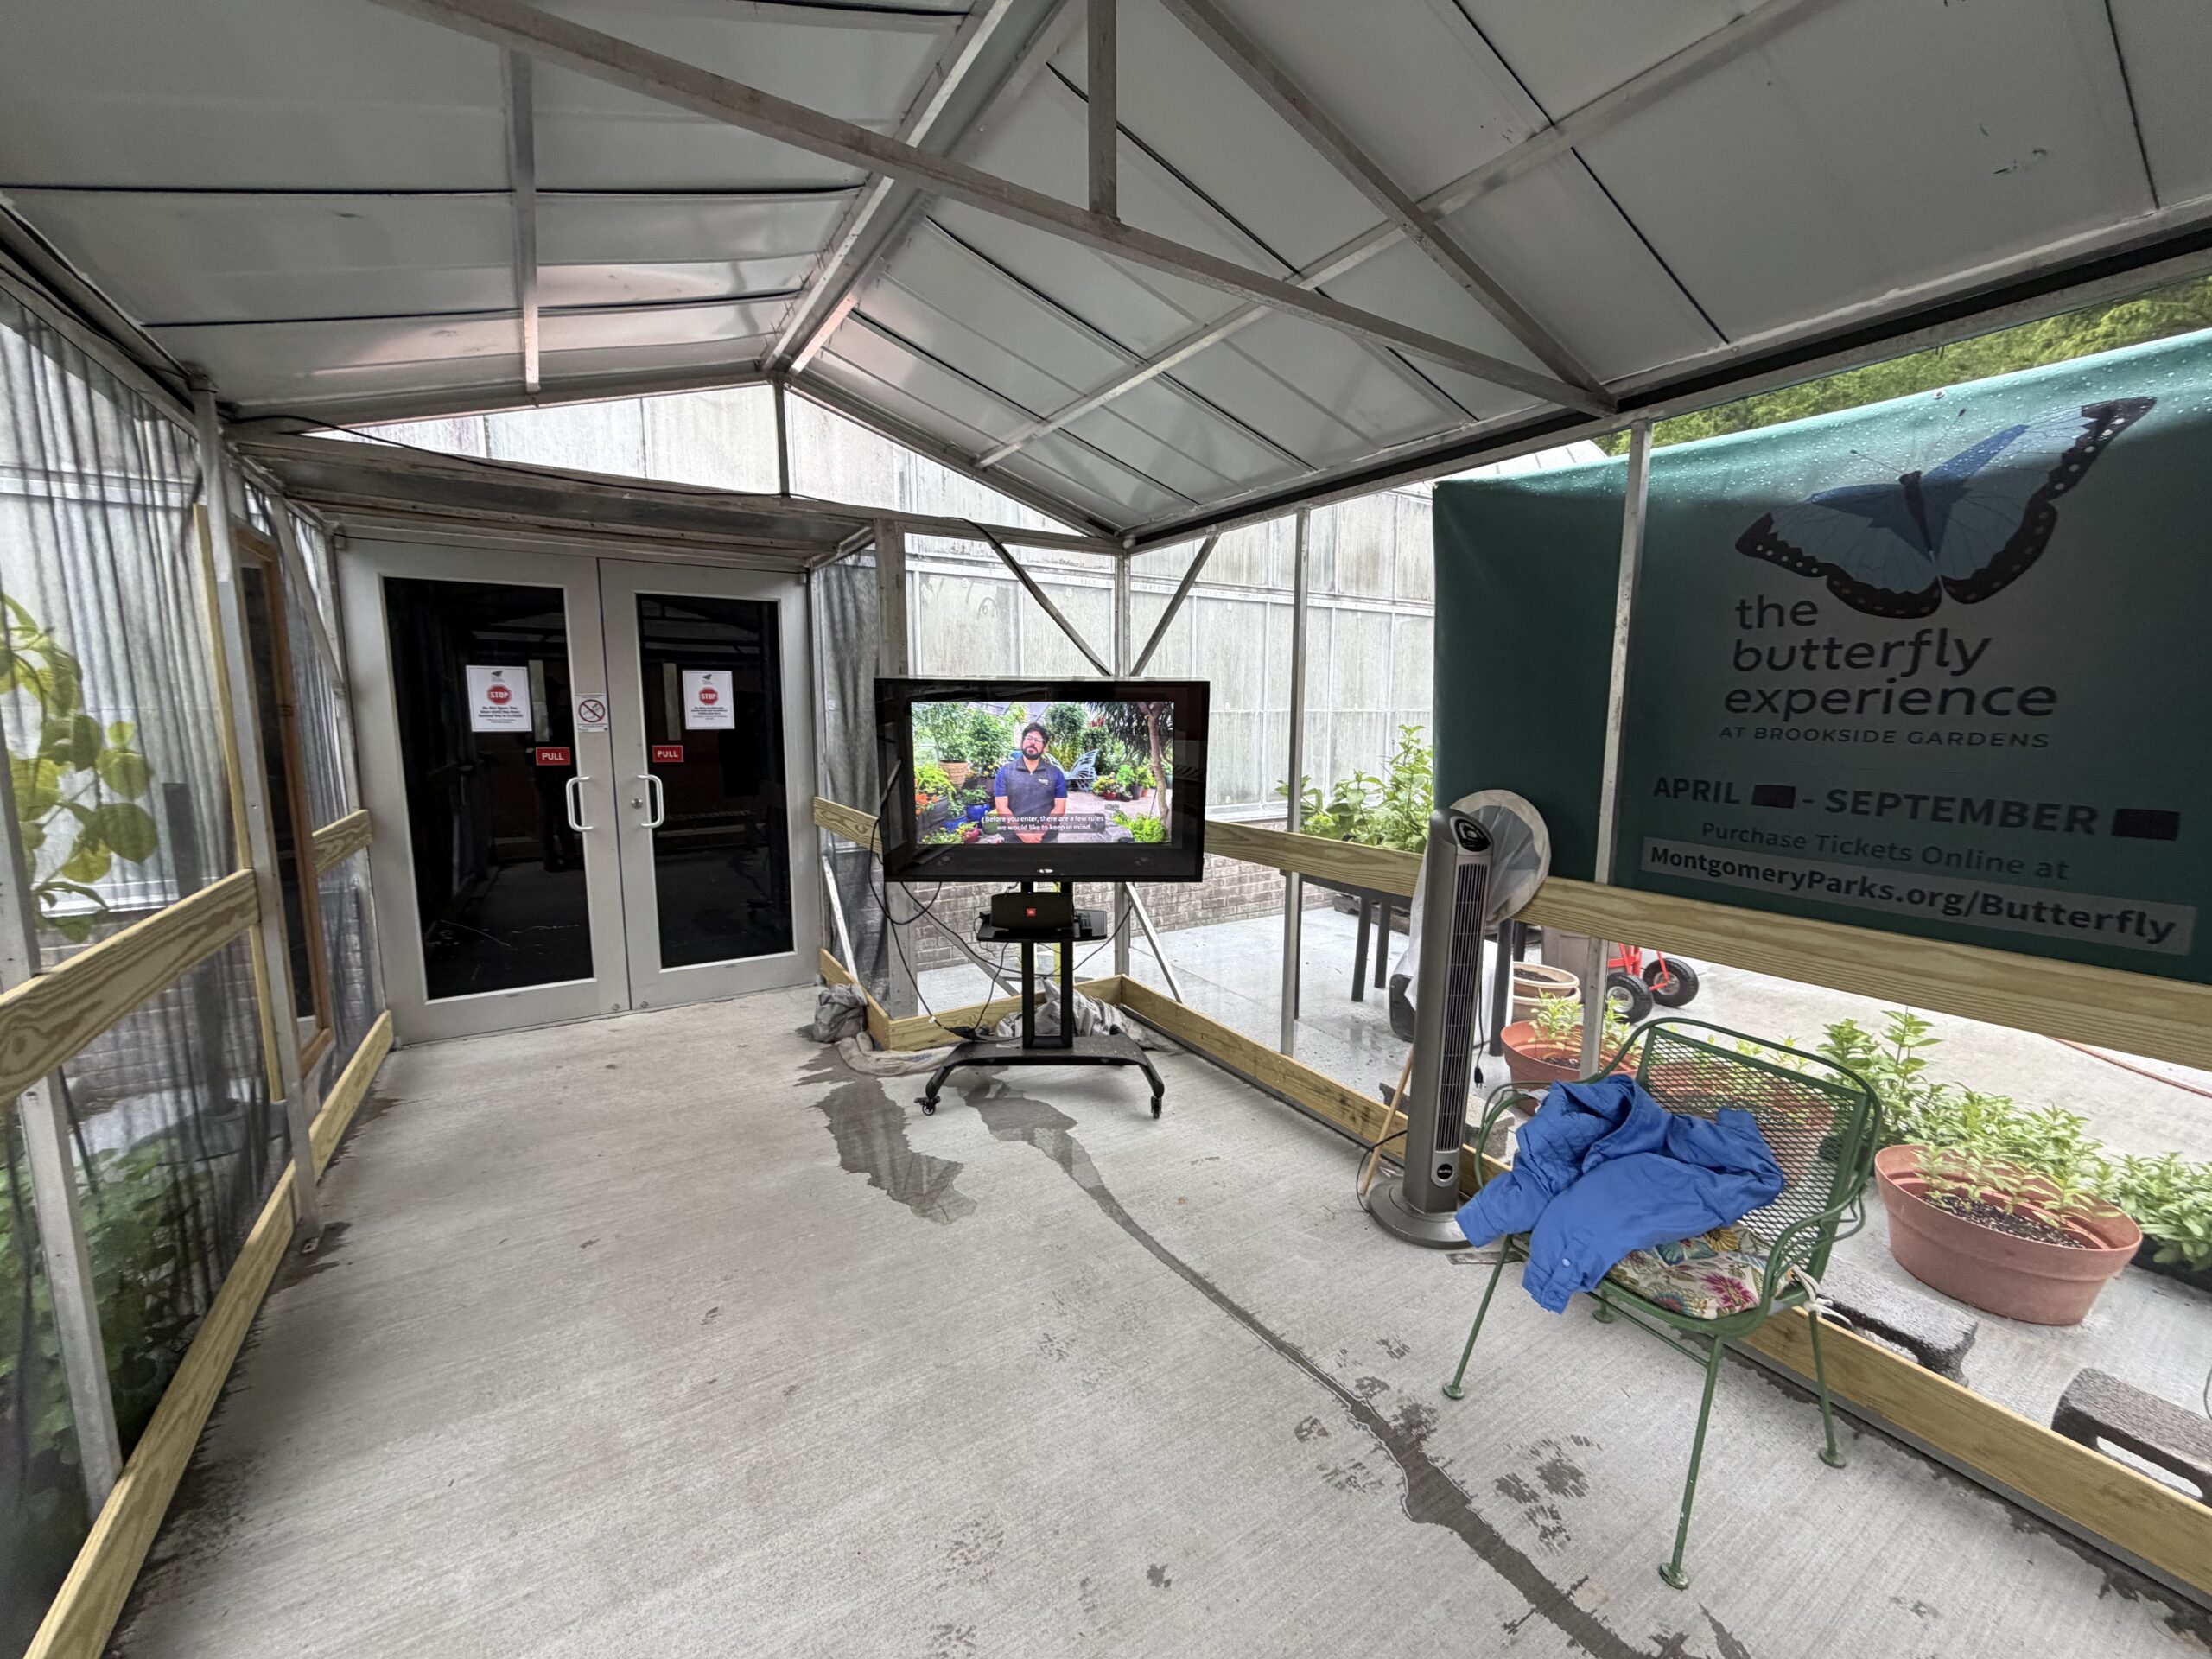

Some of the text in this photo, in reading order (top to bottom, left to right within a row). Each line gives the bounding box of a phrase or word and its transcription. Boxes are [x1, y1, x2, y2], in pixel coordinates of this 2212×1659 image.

[1735, 594, 1818, 629] the
[1732, 628, 1992, 677] butterfly
[1725, 677, 2058, 722] experience
[1719, 727, 2050, 748] AT BROOKSIDE GARDENS
[1653, 777, 1741, 804] APRIL
[1825, 789, 2099, 836] SEPTEMBER
[1702, 823, 2069, 880] Purchase Tickets Online at
[1650, 846, 2177, 944] MontgomeryParks.org/Butterfly
